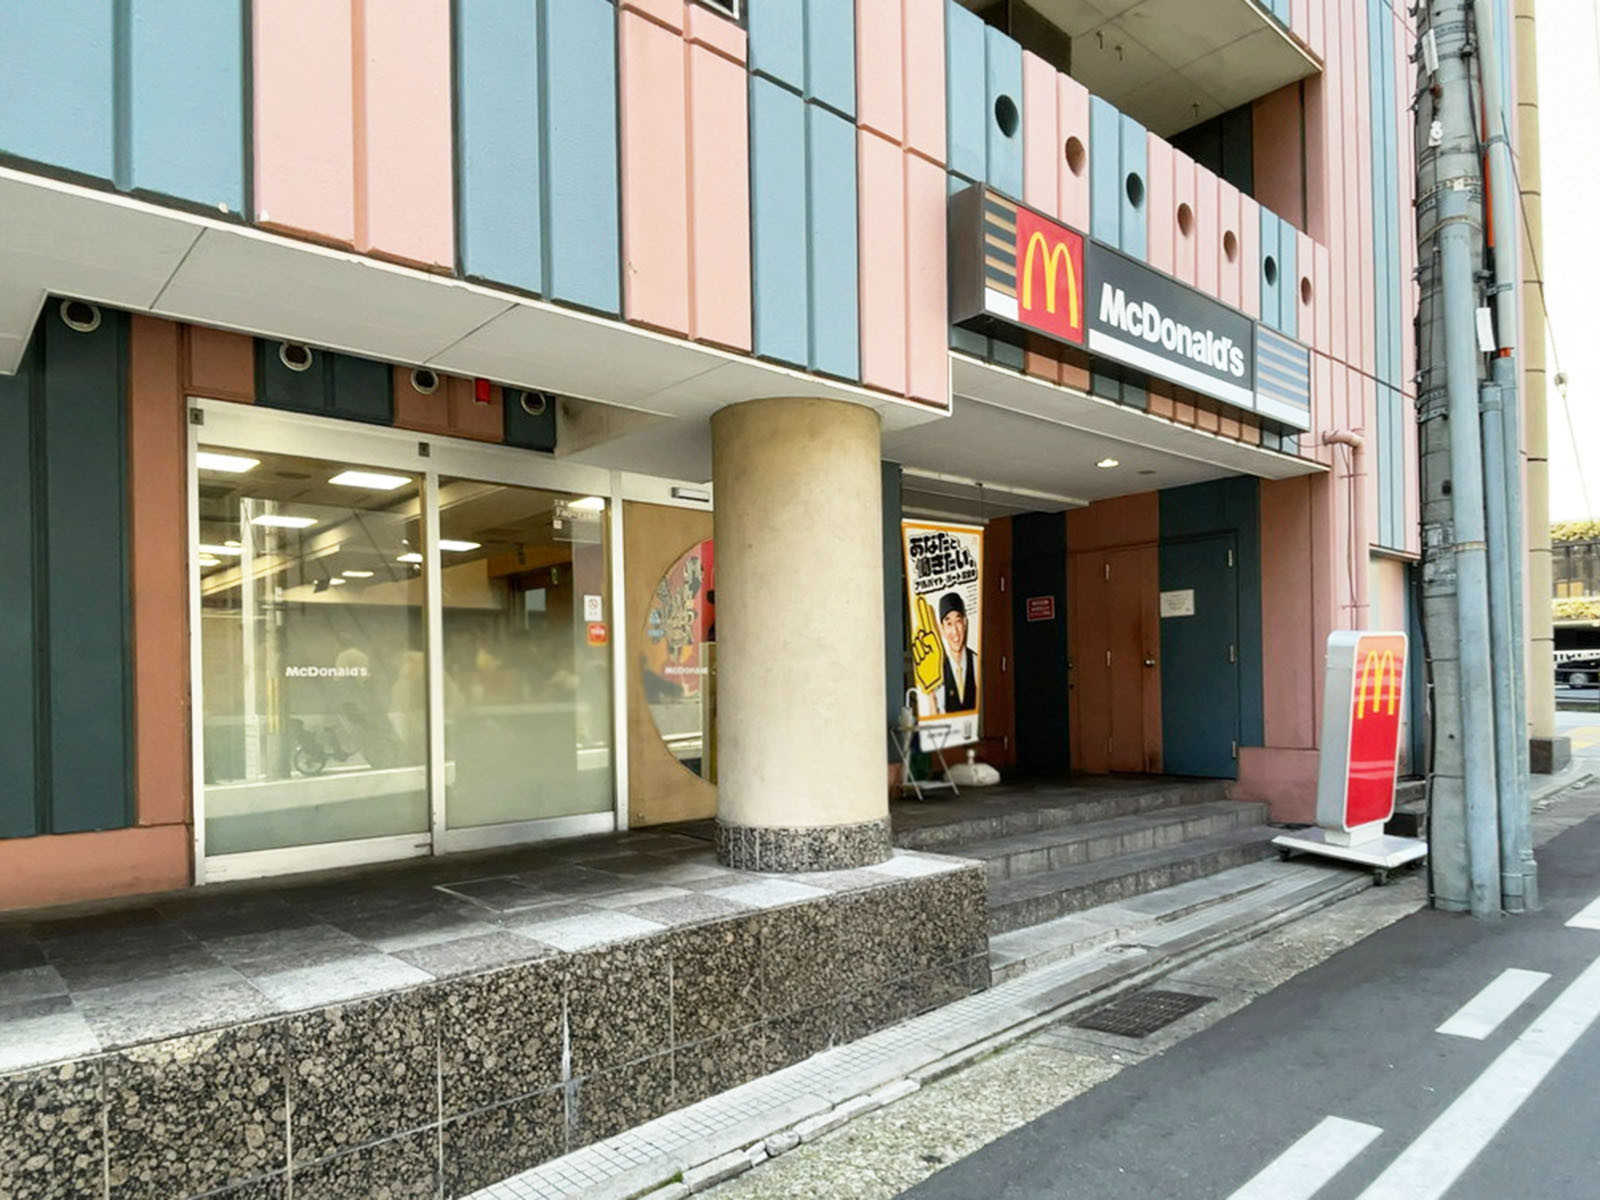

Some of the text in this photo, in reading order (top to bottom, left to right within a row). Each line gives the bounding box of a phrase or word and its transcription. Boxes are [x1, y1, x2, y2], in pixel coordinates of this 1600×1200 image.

[1099, 282, 1246, 378] McDonald's
[910, 532, 958, 558] あなたと
[285, 666, 369, 678] McDonald's
